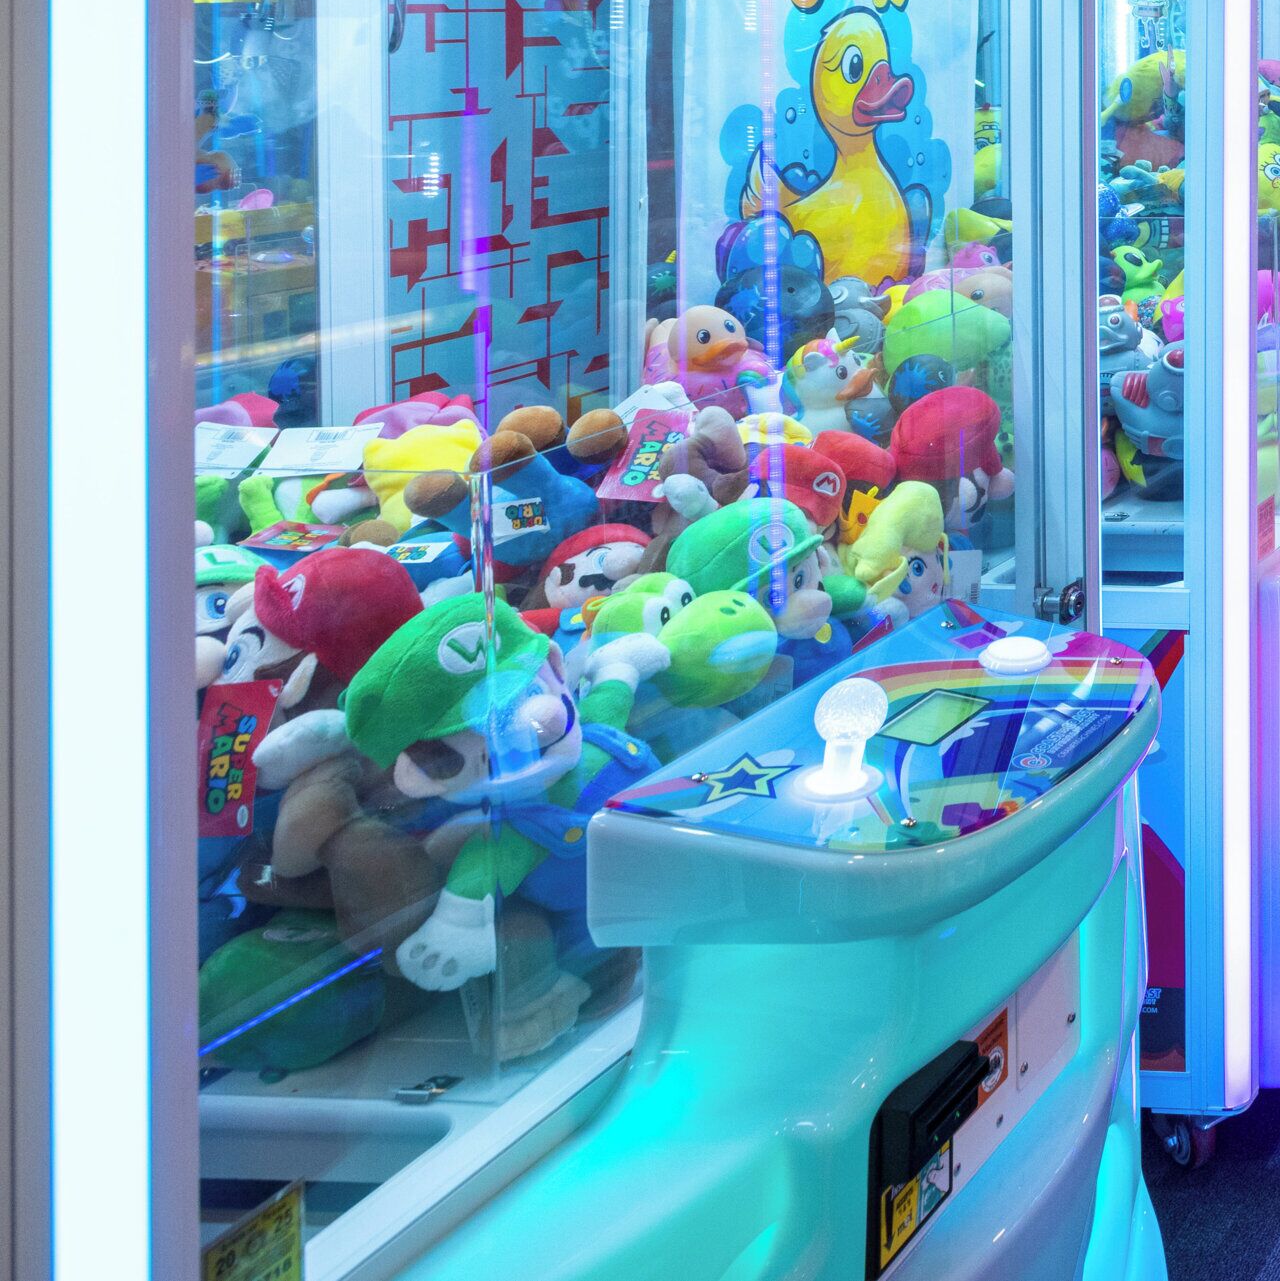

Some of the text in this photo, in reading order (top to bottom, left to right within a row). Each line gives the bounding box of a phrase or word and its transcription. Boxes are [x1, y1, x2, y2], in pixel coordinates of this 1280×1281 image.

[620, 420, 672, 487] MARIO
[208, 702, 243, 814] MARIO
[226, 714, 257, 801] SUPER
